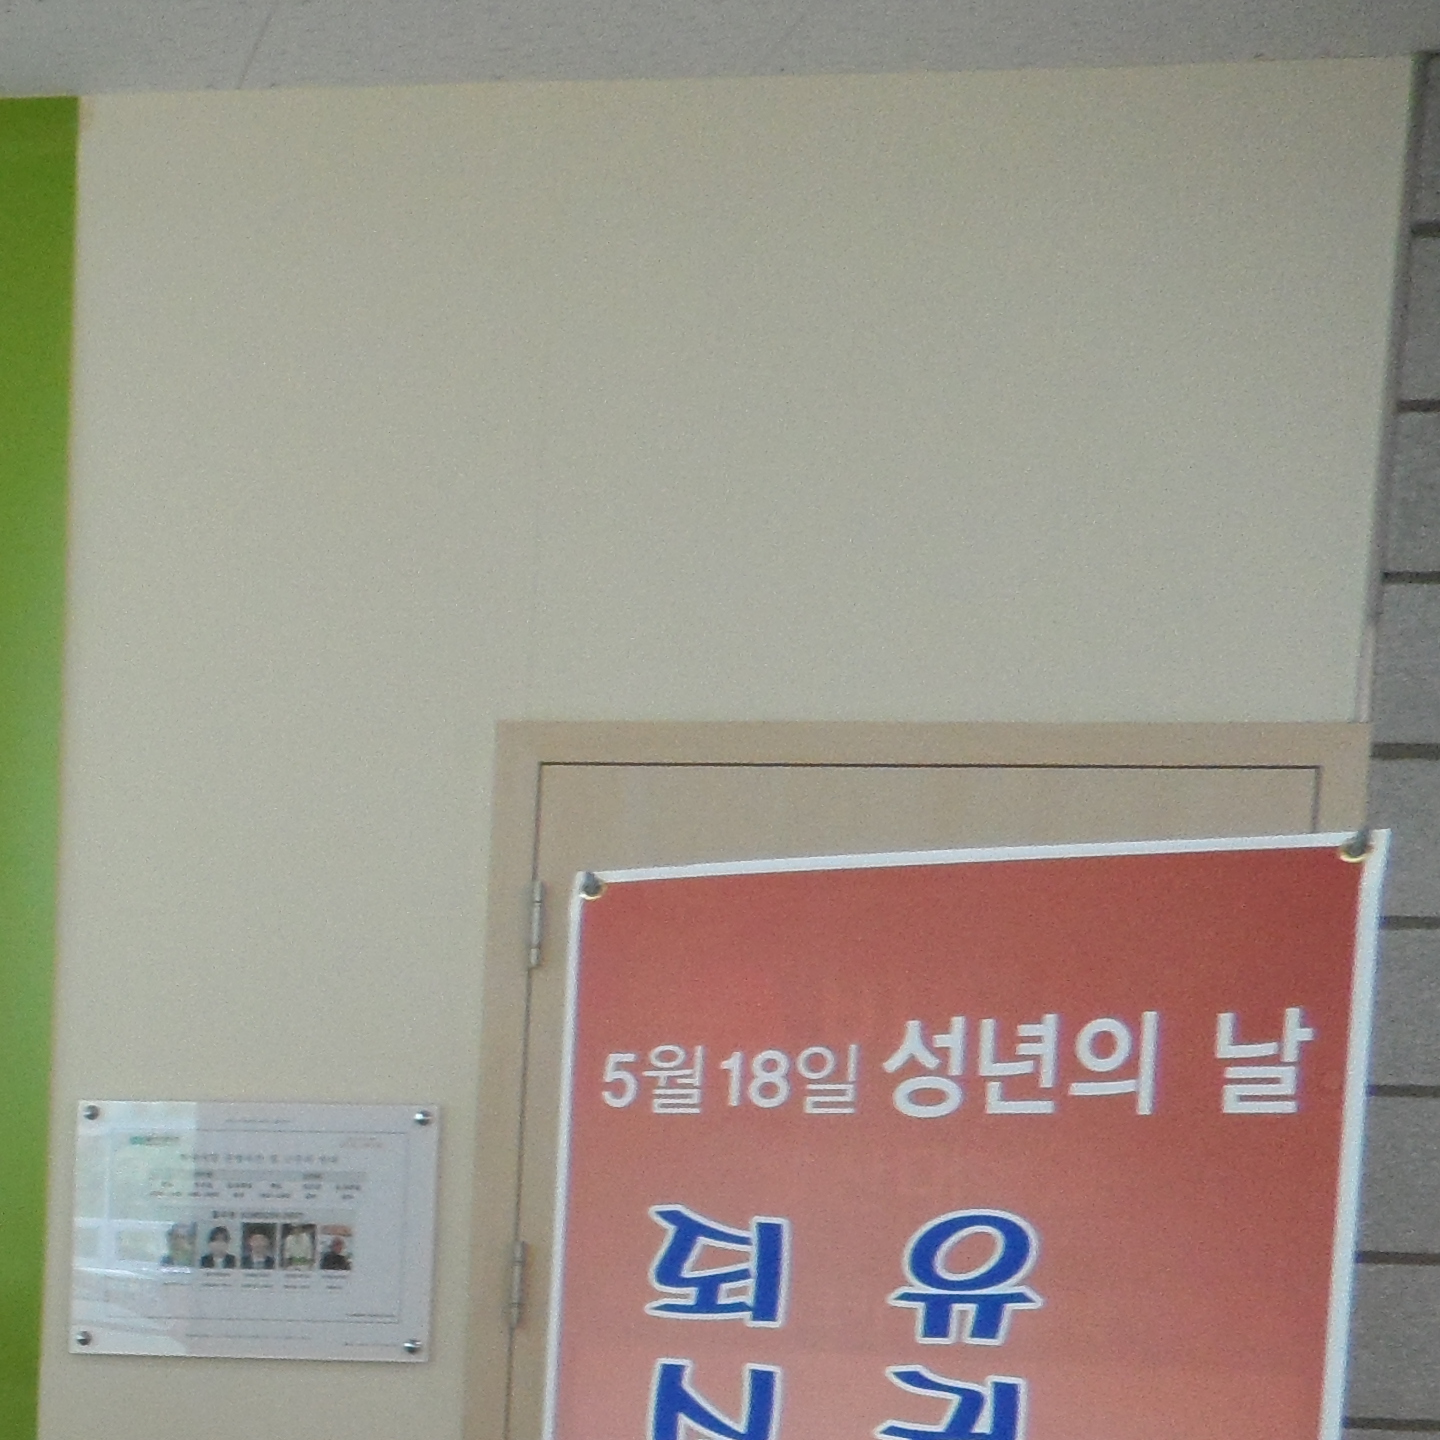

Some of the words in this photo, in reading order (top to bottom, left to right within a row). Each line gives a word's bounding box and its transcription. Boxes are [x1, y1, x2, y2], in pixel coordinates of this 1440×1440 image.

[601, 1042, 706, 1116] 5월
[720, 1042, 860, 1116] 18일
[882, 1010, 1159, 1118] 성년의
[1213, 1007, 1315, 1116] 날
